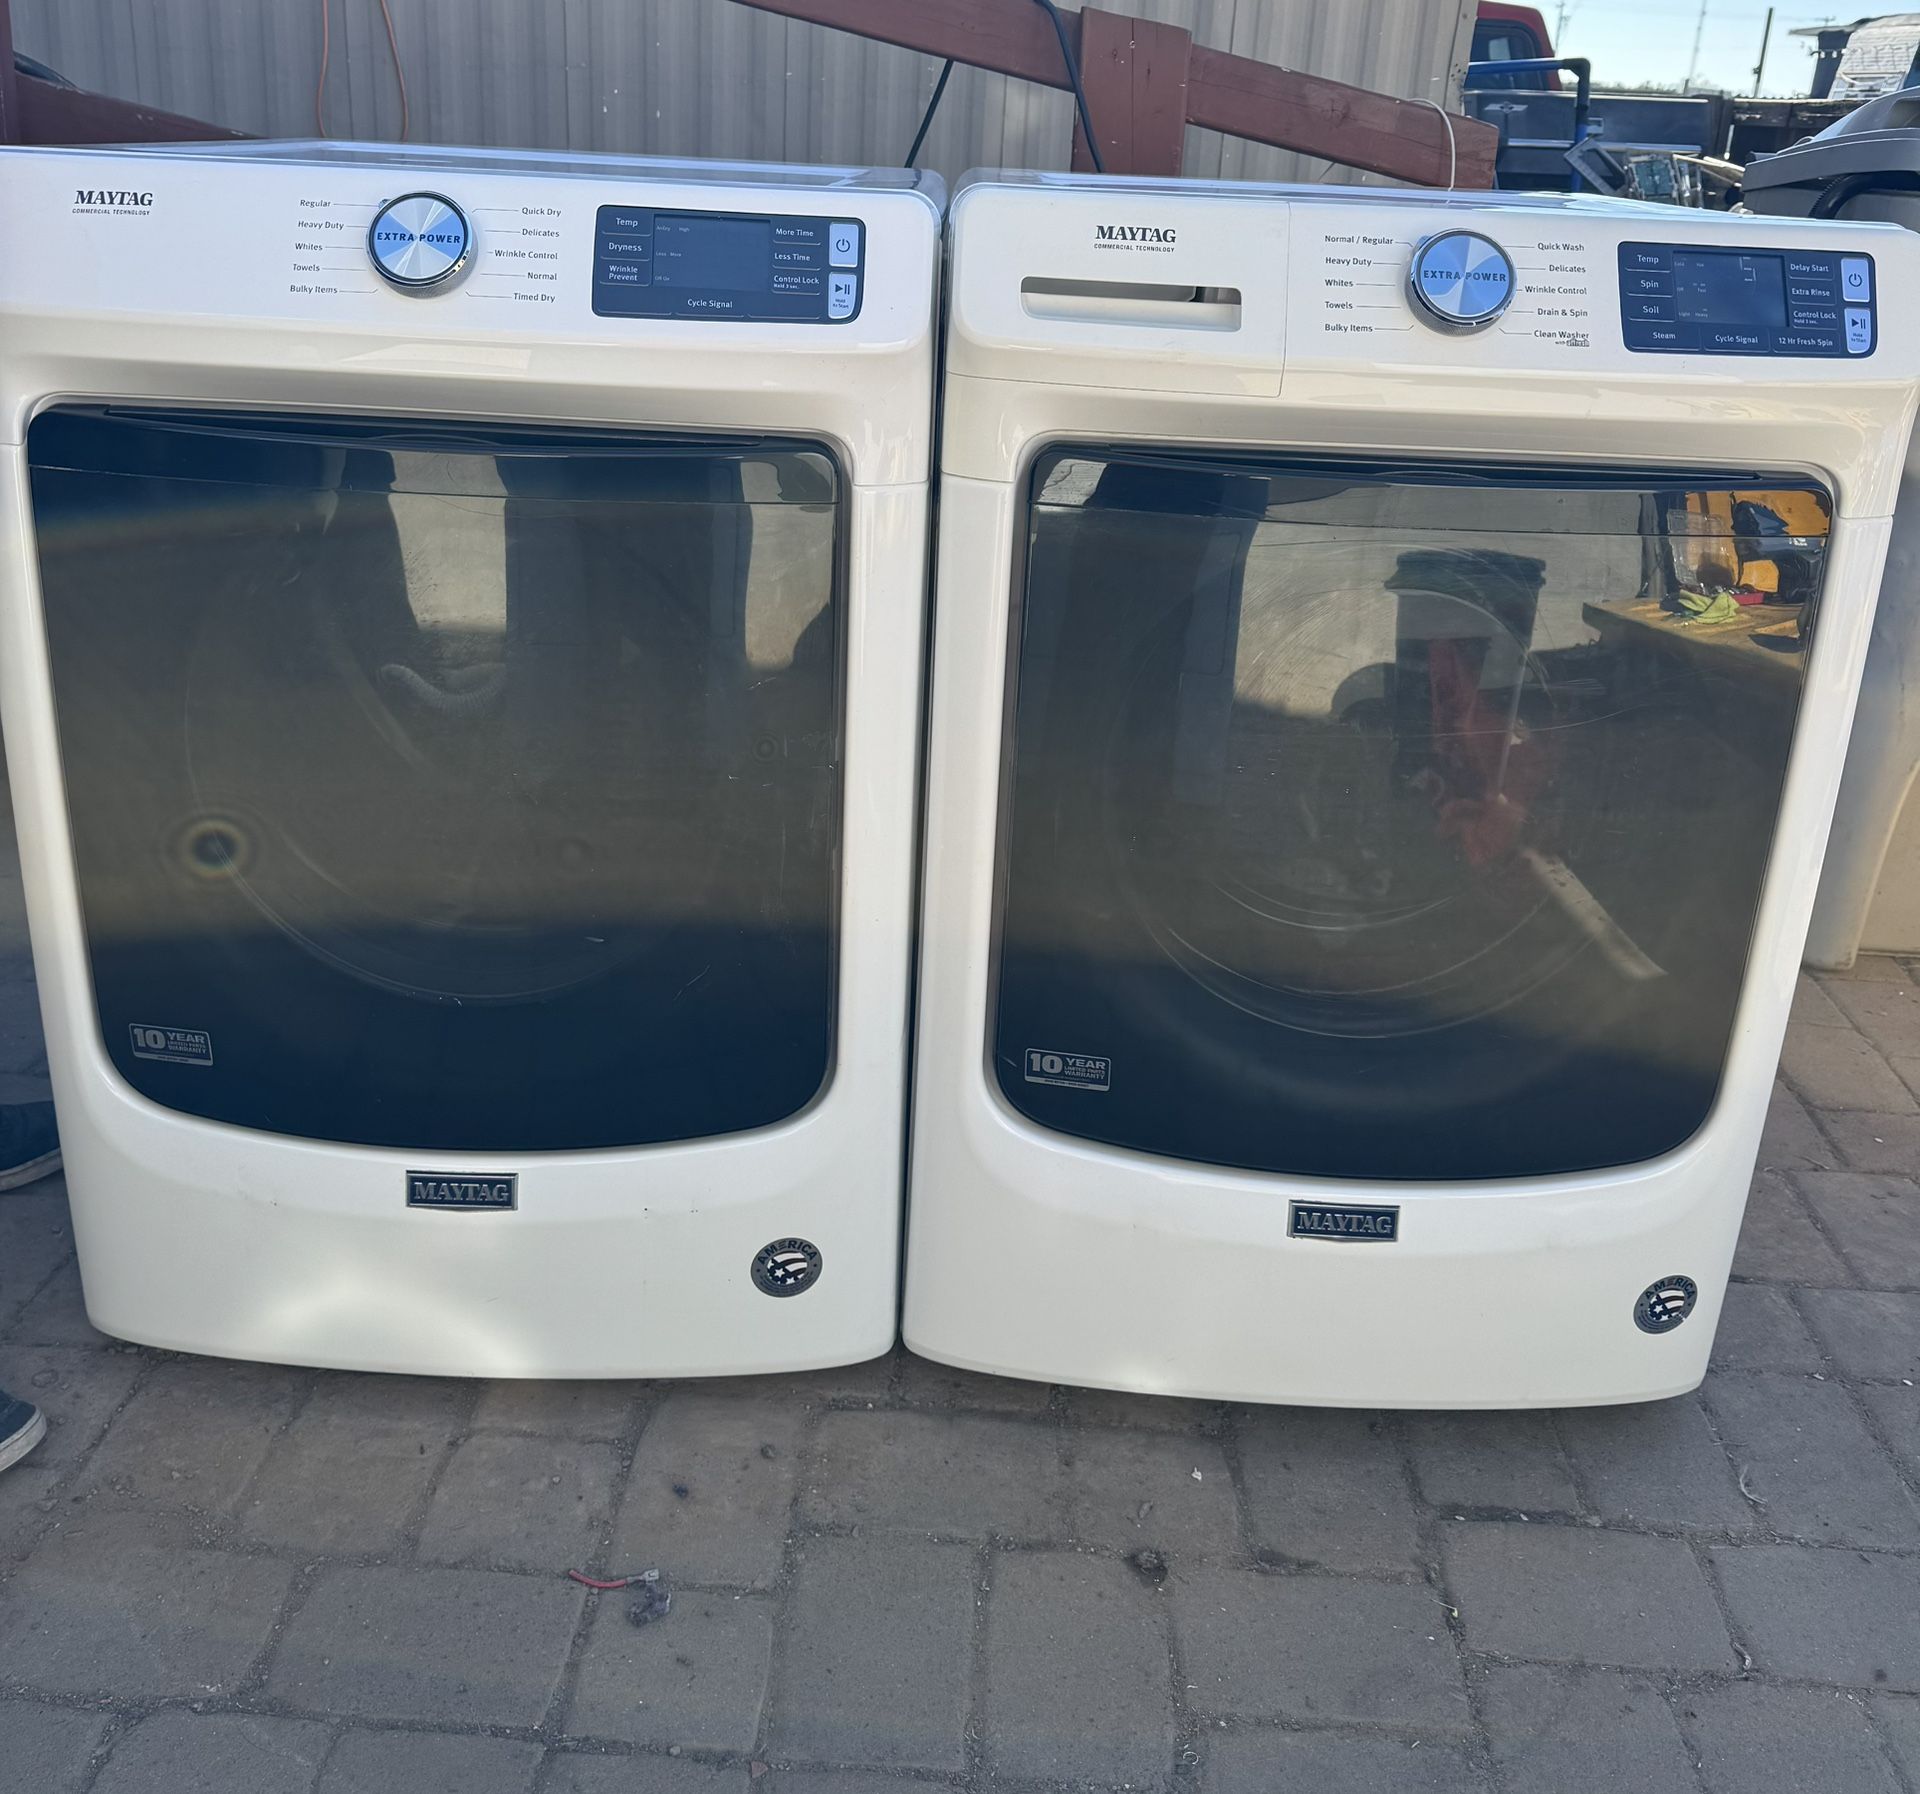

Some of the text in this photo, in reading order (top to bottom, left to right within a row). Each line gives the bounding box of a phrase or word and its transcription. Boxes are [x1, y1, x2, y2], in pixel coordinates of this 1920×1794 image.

[74, 190, 154, 207] MAYTAG
[299, 199, 332, 209] Regular
[521, 207, 562, 218] Quick Dry
[297, 220, 345, 231] Heavy Duty
[615, 217, 639, 229] Temp
[521, 228, 561, 238] Delicates
[775, 228, 814, 237] More Time
[1095, 225, 1177, 243] MAYTAG
[376, 232, 462, 244] EXTRA POWER
[1324, 235, 1394, 246] Normal / Regular
[294, 242, 323, 251] Whites
[608, 242, 643, 253] Dryness
[1093, 243, 1175, 253] COMMERCIAL TECHNOLOGY
[1537, 242, 1585, 252] Quick Wash
[494, 249, 558, 260] Wrinkle Control
[774, 252, 811, 262] Less Time
[1636, 254, 1660, 265] Temp
[292, 263, 321, 272] Towels
[1325, 257, 1372, 268] Heavy Duty
[609, 265, 638, 273] Wrinkle
[1548, 264, 1587, 274] Delicates
[1790, 263, 1829, 273] Delay Start
[527, 271, 558, 281] Normal
[609, 272, 639, 282] Prevent
[773, 275, 820, 285] Control Lock
[1423, 270, 1507, 282] EXTRA POWER
[1324, 279, 1354, 288] Whites
[1640, 280, 1660, 290] Spin
[289, 284, 338, 295] Bulky Items
[1524, 285, 1588, 295] Wrinkle Control
[1791, 288, 1831, 297] Extra Rinse
[513, 292, 556, 303] Timed Dry
[687, 299, 733, 310] Cycle Signal
[1324, 301, 1354, 310] Towels
[1642, 305, 1660, 314] Soil
[1537, 308, 1588, 318] Drain & Spin
[1793, 310, 1837, 319] Control Lock
[1324, 323, 1373, 334] Bulky Items
[1533, 329, 1590, 339] Clean Washer
[1652, 331, 1676, 340] Steam
[1715, 334, 1759, 345] Cycle Signal
[1778, 337, 1833, 348] 12 Hr Fresh Spin
[133, 1028, 205, 1049] 10 YEAR
[168, 1045, 207, 1054] WARRANTY
[1030, 1053, 1106, 1074] 10 YEAR
[1064, 1065, 1087, 1073] LIMITED
[1064, 1070, 1105, 1080] WARRANTY
[413, 1181, 509, 1201] MAYTAG
[1297, 1211, 1393, 1234] MAYTAG
[757, 1240, 818, 1265] AMERICA
[1645, 1277, 1696, 1299] AMERICA
